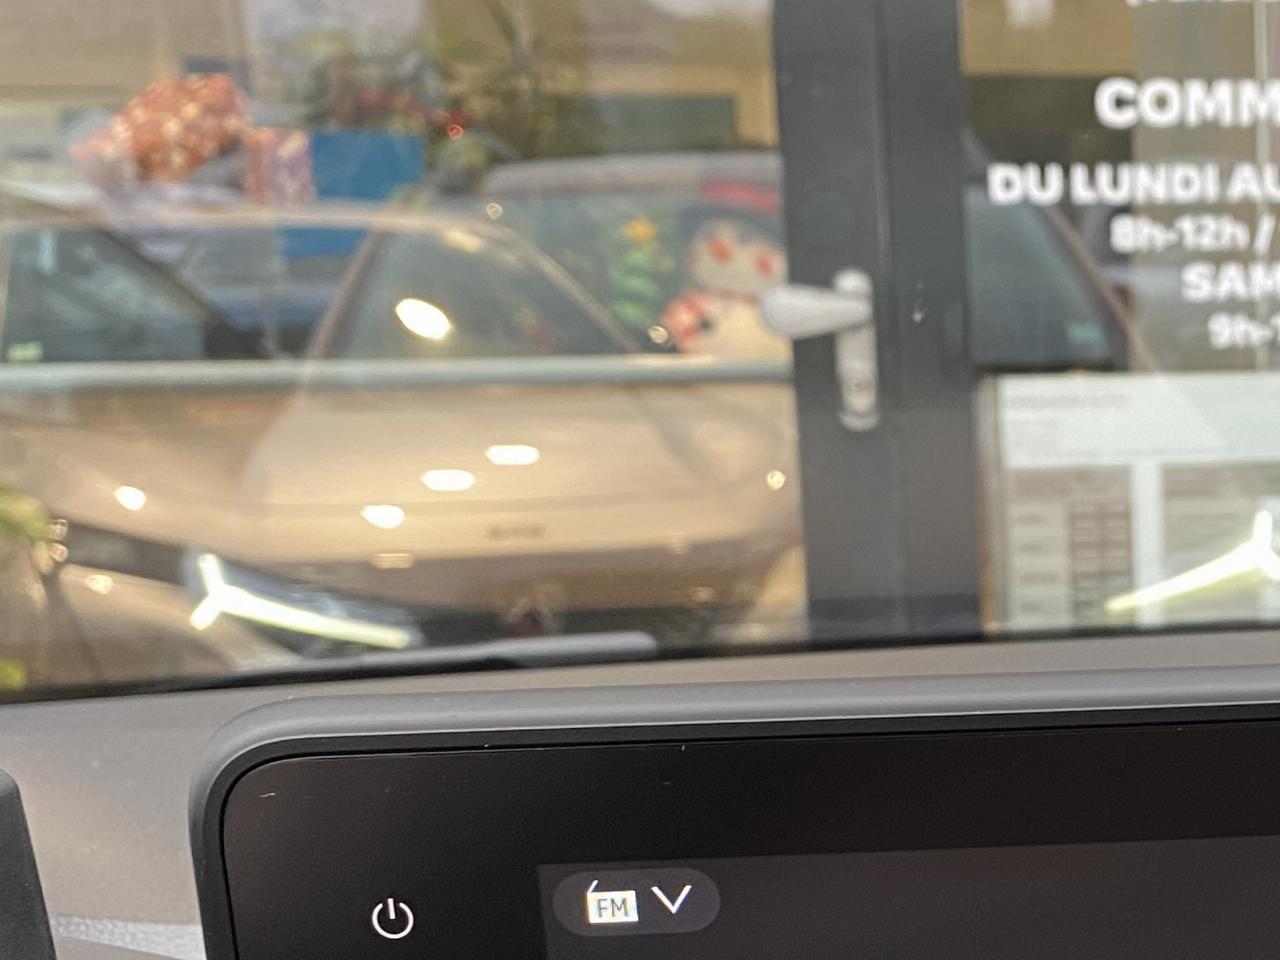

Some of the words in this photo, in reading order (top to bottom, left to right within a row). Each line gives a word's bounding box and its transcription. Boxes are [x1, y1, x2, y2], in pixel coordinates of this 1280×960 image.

[987, 161, 1064, 205] DU
[1068, 161, 1219, 205] LUNDI
[1109, 214, 1250, 253] 8h-12h
[595, 897, 630, 919] FM
